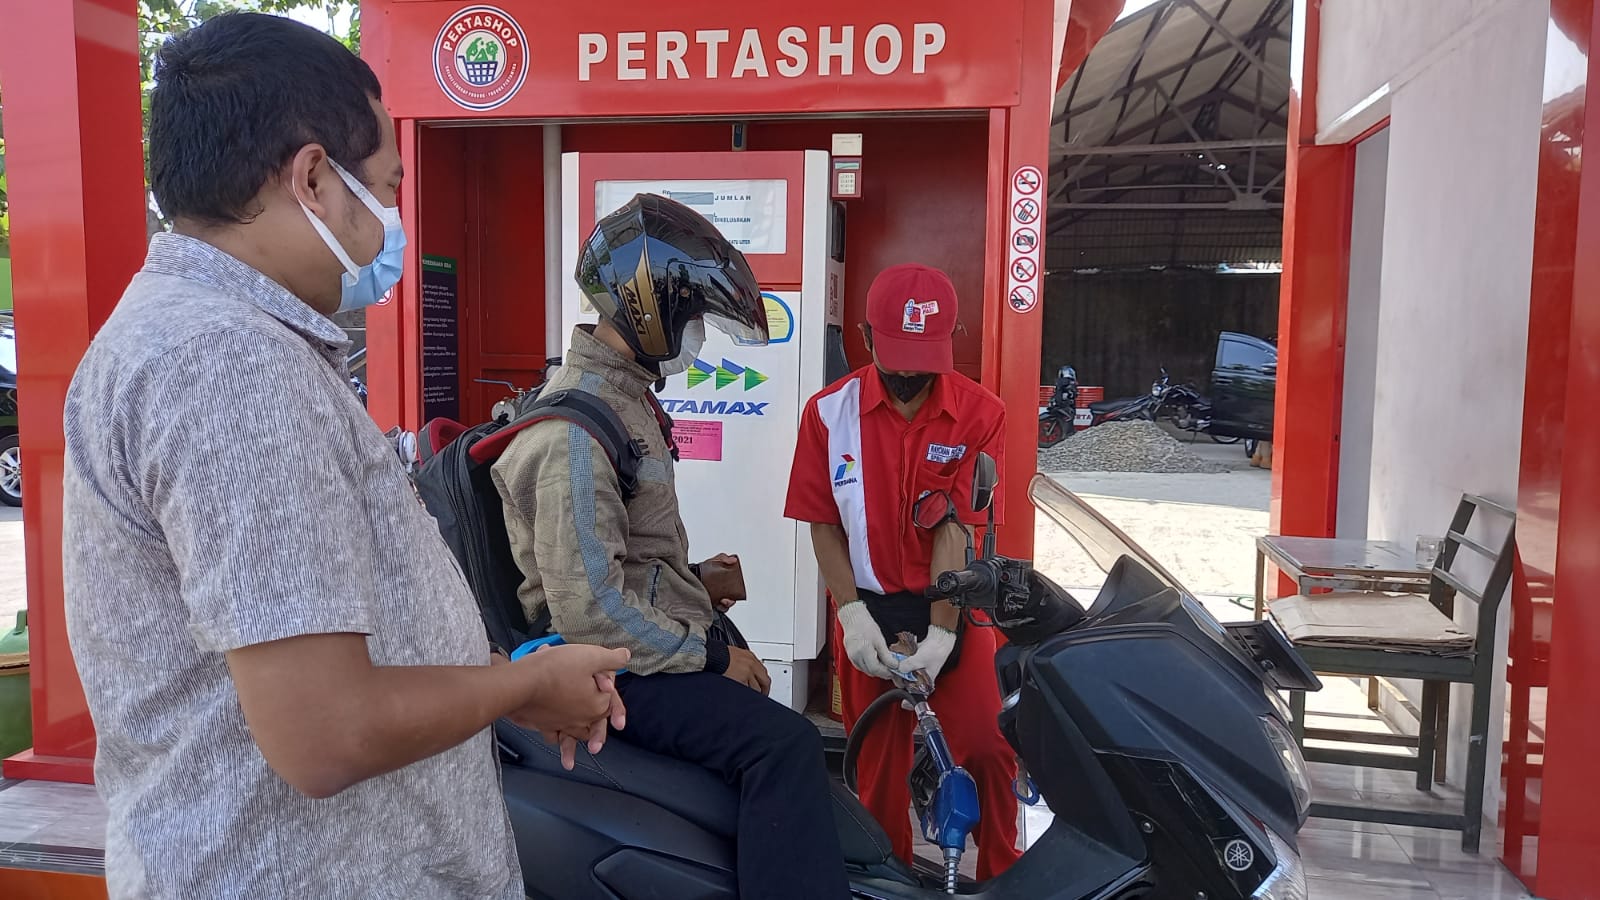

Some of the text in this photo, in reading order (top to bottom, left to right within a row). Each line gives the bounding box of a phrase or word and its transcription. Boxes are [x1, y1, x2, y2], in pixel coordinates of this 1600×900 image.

[443, 15, 518, 51] PERTASHOP
[578, 22, 946, 82] PERTASHOP
[672, 435, 693, 445] 2021
